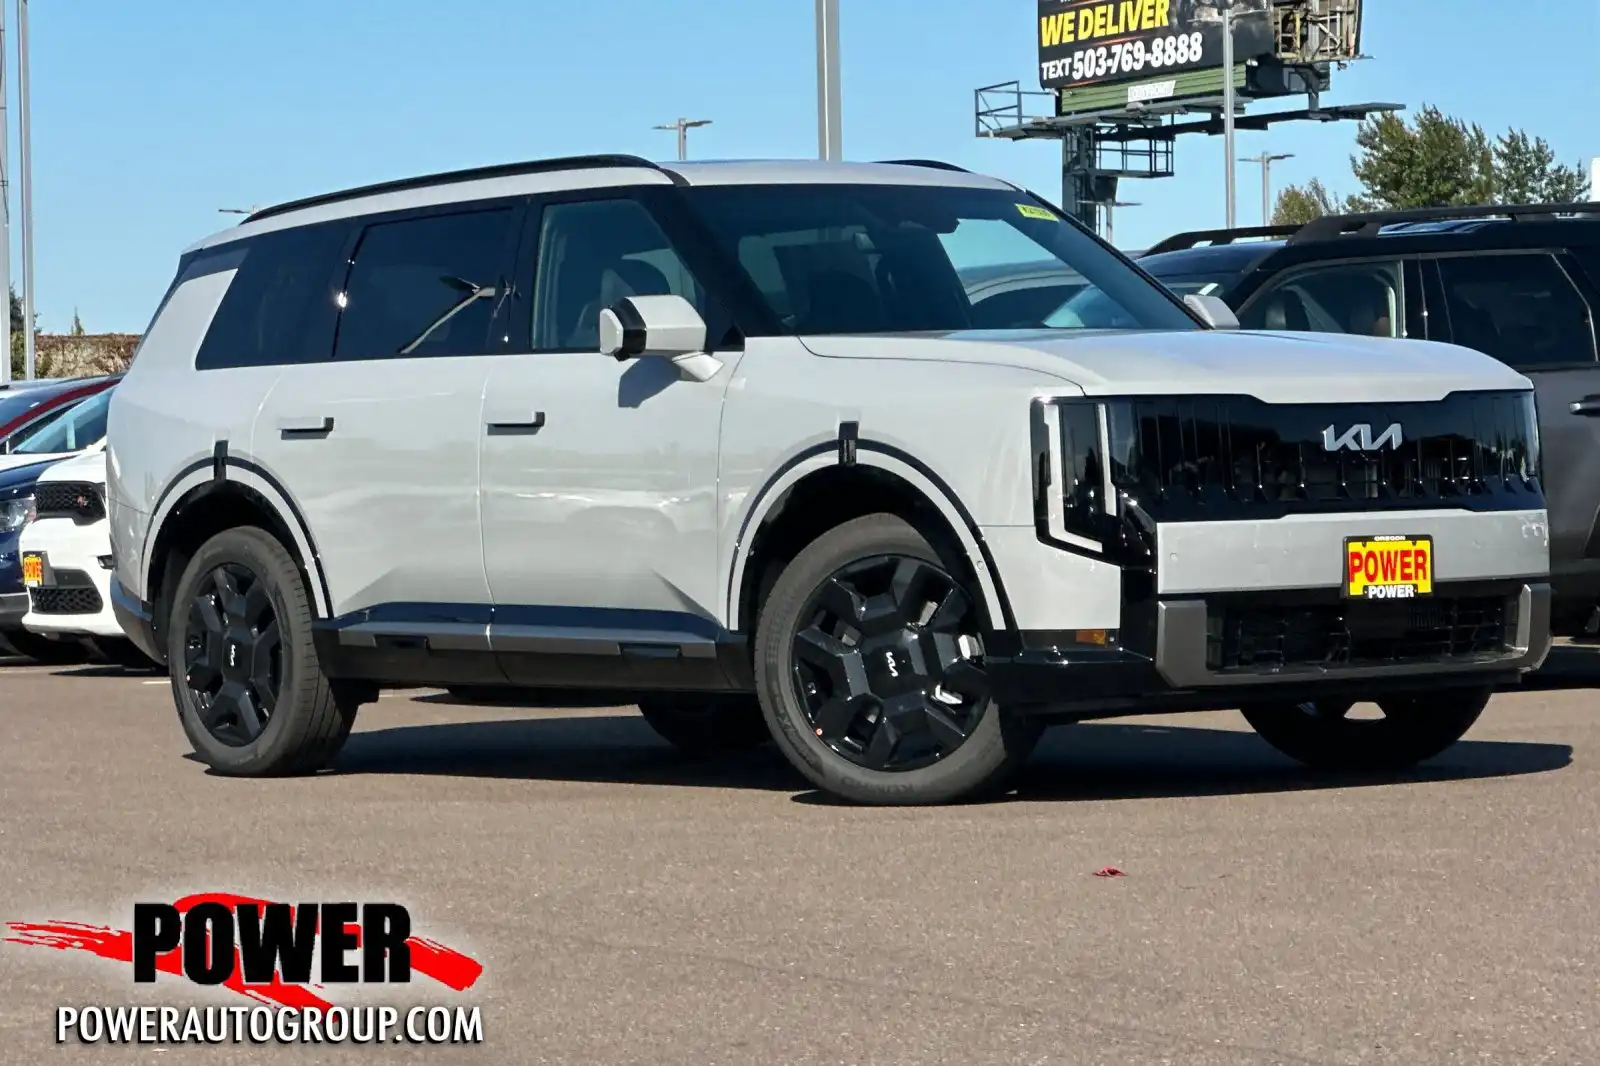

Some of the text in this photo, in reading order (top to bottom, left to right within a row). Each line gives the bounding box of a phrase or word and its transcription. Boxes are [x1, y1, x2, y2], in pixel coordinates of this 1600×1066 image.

[1041, 0, 1170, 47] WE DELIVER
[1041, 31, 1203, 80] TEXT 503-769-8888
[1322, 423, 1403, 451] KIA
[1349, 549, 1427, 583] POWER
[1368, 584, 1414, 599] POWER
